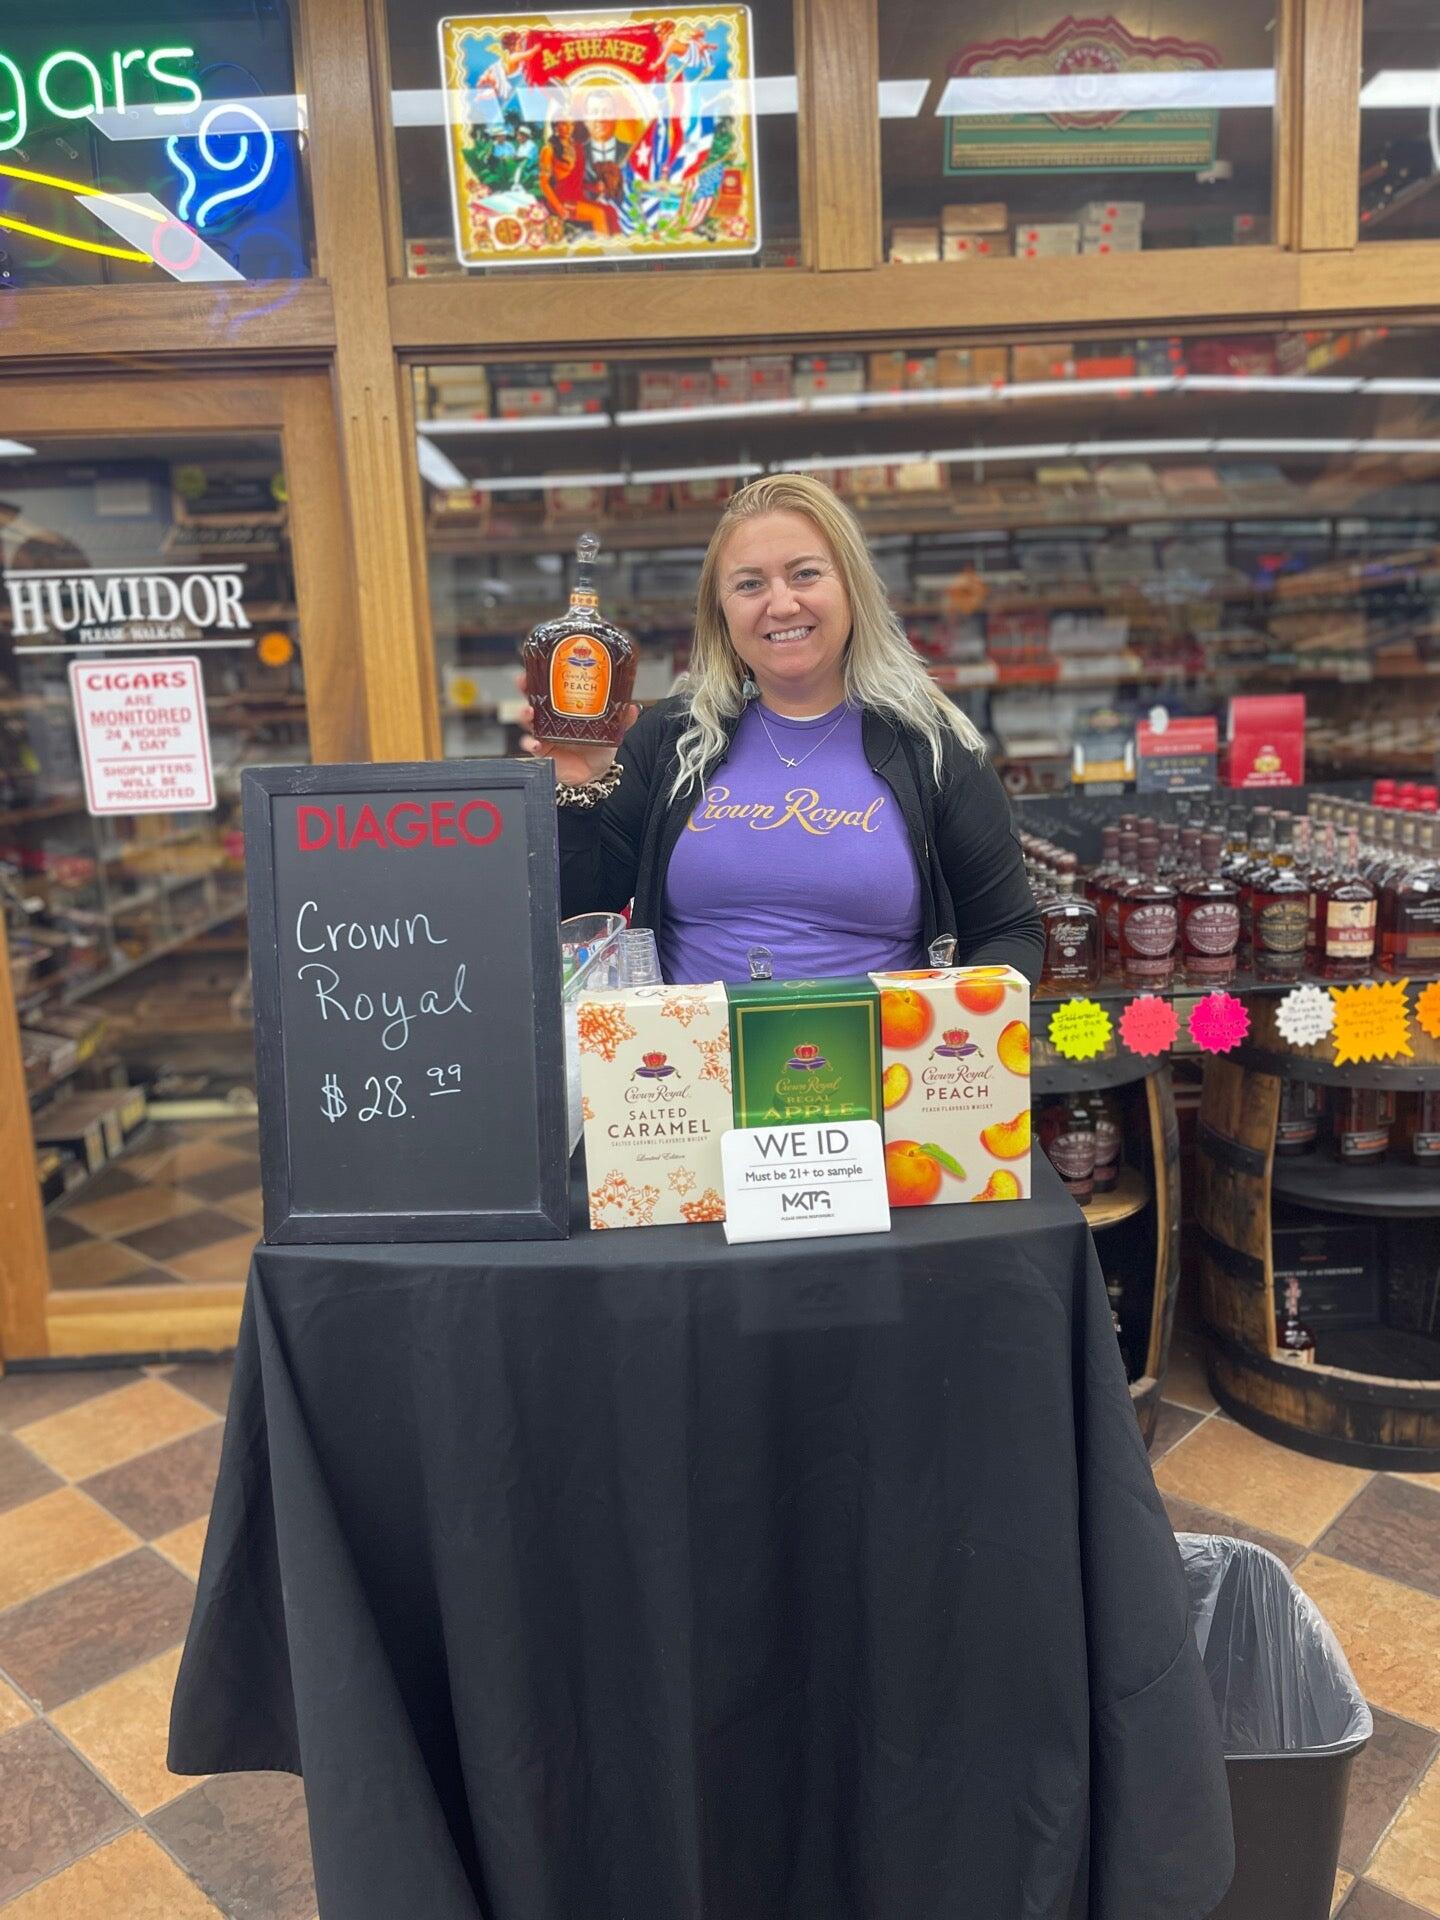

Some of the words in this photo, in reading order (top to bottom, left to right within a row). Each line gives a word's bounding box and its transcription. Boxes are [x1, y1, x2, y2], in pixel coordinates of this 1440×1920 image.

[562, 39, 647, 66] FUENTE
[5, 574, 252, 636] HUMIDOR
[80, 627, 123, 642] PLEASE
[86, 672, 187, 691] CIGARS
[563, 681, 598, 692] PEACH
[124, 694, 153, 706] ARE
[90, 707, 192, 727] MONITORED
[105, 729, 121, 740] 24
[130, 727, 181, 738] HOURS
[122, 741, 132, 752] A
[139, 740, 167, 751] DAY
[104, 763, 193, 776] SHOPLIFTERS
[121, 779, 152, 788] WILL
[161, 777, 176, 786] BE
[107, 787, 195, 800] PROSECUTED
[687, 786, 775, 832] Crown
[750, 788, 886, 835] Royal
[296, 800, 503, 851] DIAGEO
[1133, 905, 1177, 922] REBEL
[1193, 903, 1238, 920] REBEL
[296, 900, 448, 954] Crown
[298, 963, 473, 1051] Royal
[921, 1066, 955, 1085] Crown
[947, 1064, 994, 1084] Royal
[624, 1086, 655, 1104] Crown
[647, 1085, 691, 1103] Royal
[775, 1078, 807, 1095] Crown
[799, 1076, 842, 1094] Royal
[926, 1085, 989, 1101] PEACH
[786, 1095, 832, 1104] REGAL
[629, 1107, 687, 1121] SALTED
[763, 1103, 855, 1121] APPLE
[607, 1119, 711, 1138] CARAMEL
[753, 1131, 807, 1159] WE
[818, 1129, 849, 1155] ID
[636, 1153, 661, 1162] Limited
[661, 1152, 686, 1161] Edition
[745, 1171, 772, 1182] Must
[774, 1170, 787, 1180] be
[789, 1168, 810, 1179] 21+
[813, 1168, 824, 1177] to
[827, 1164, 863, 1179] sample
[781, 1191, 831, 1212] MKTG
